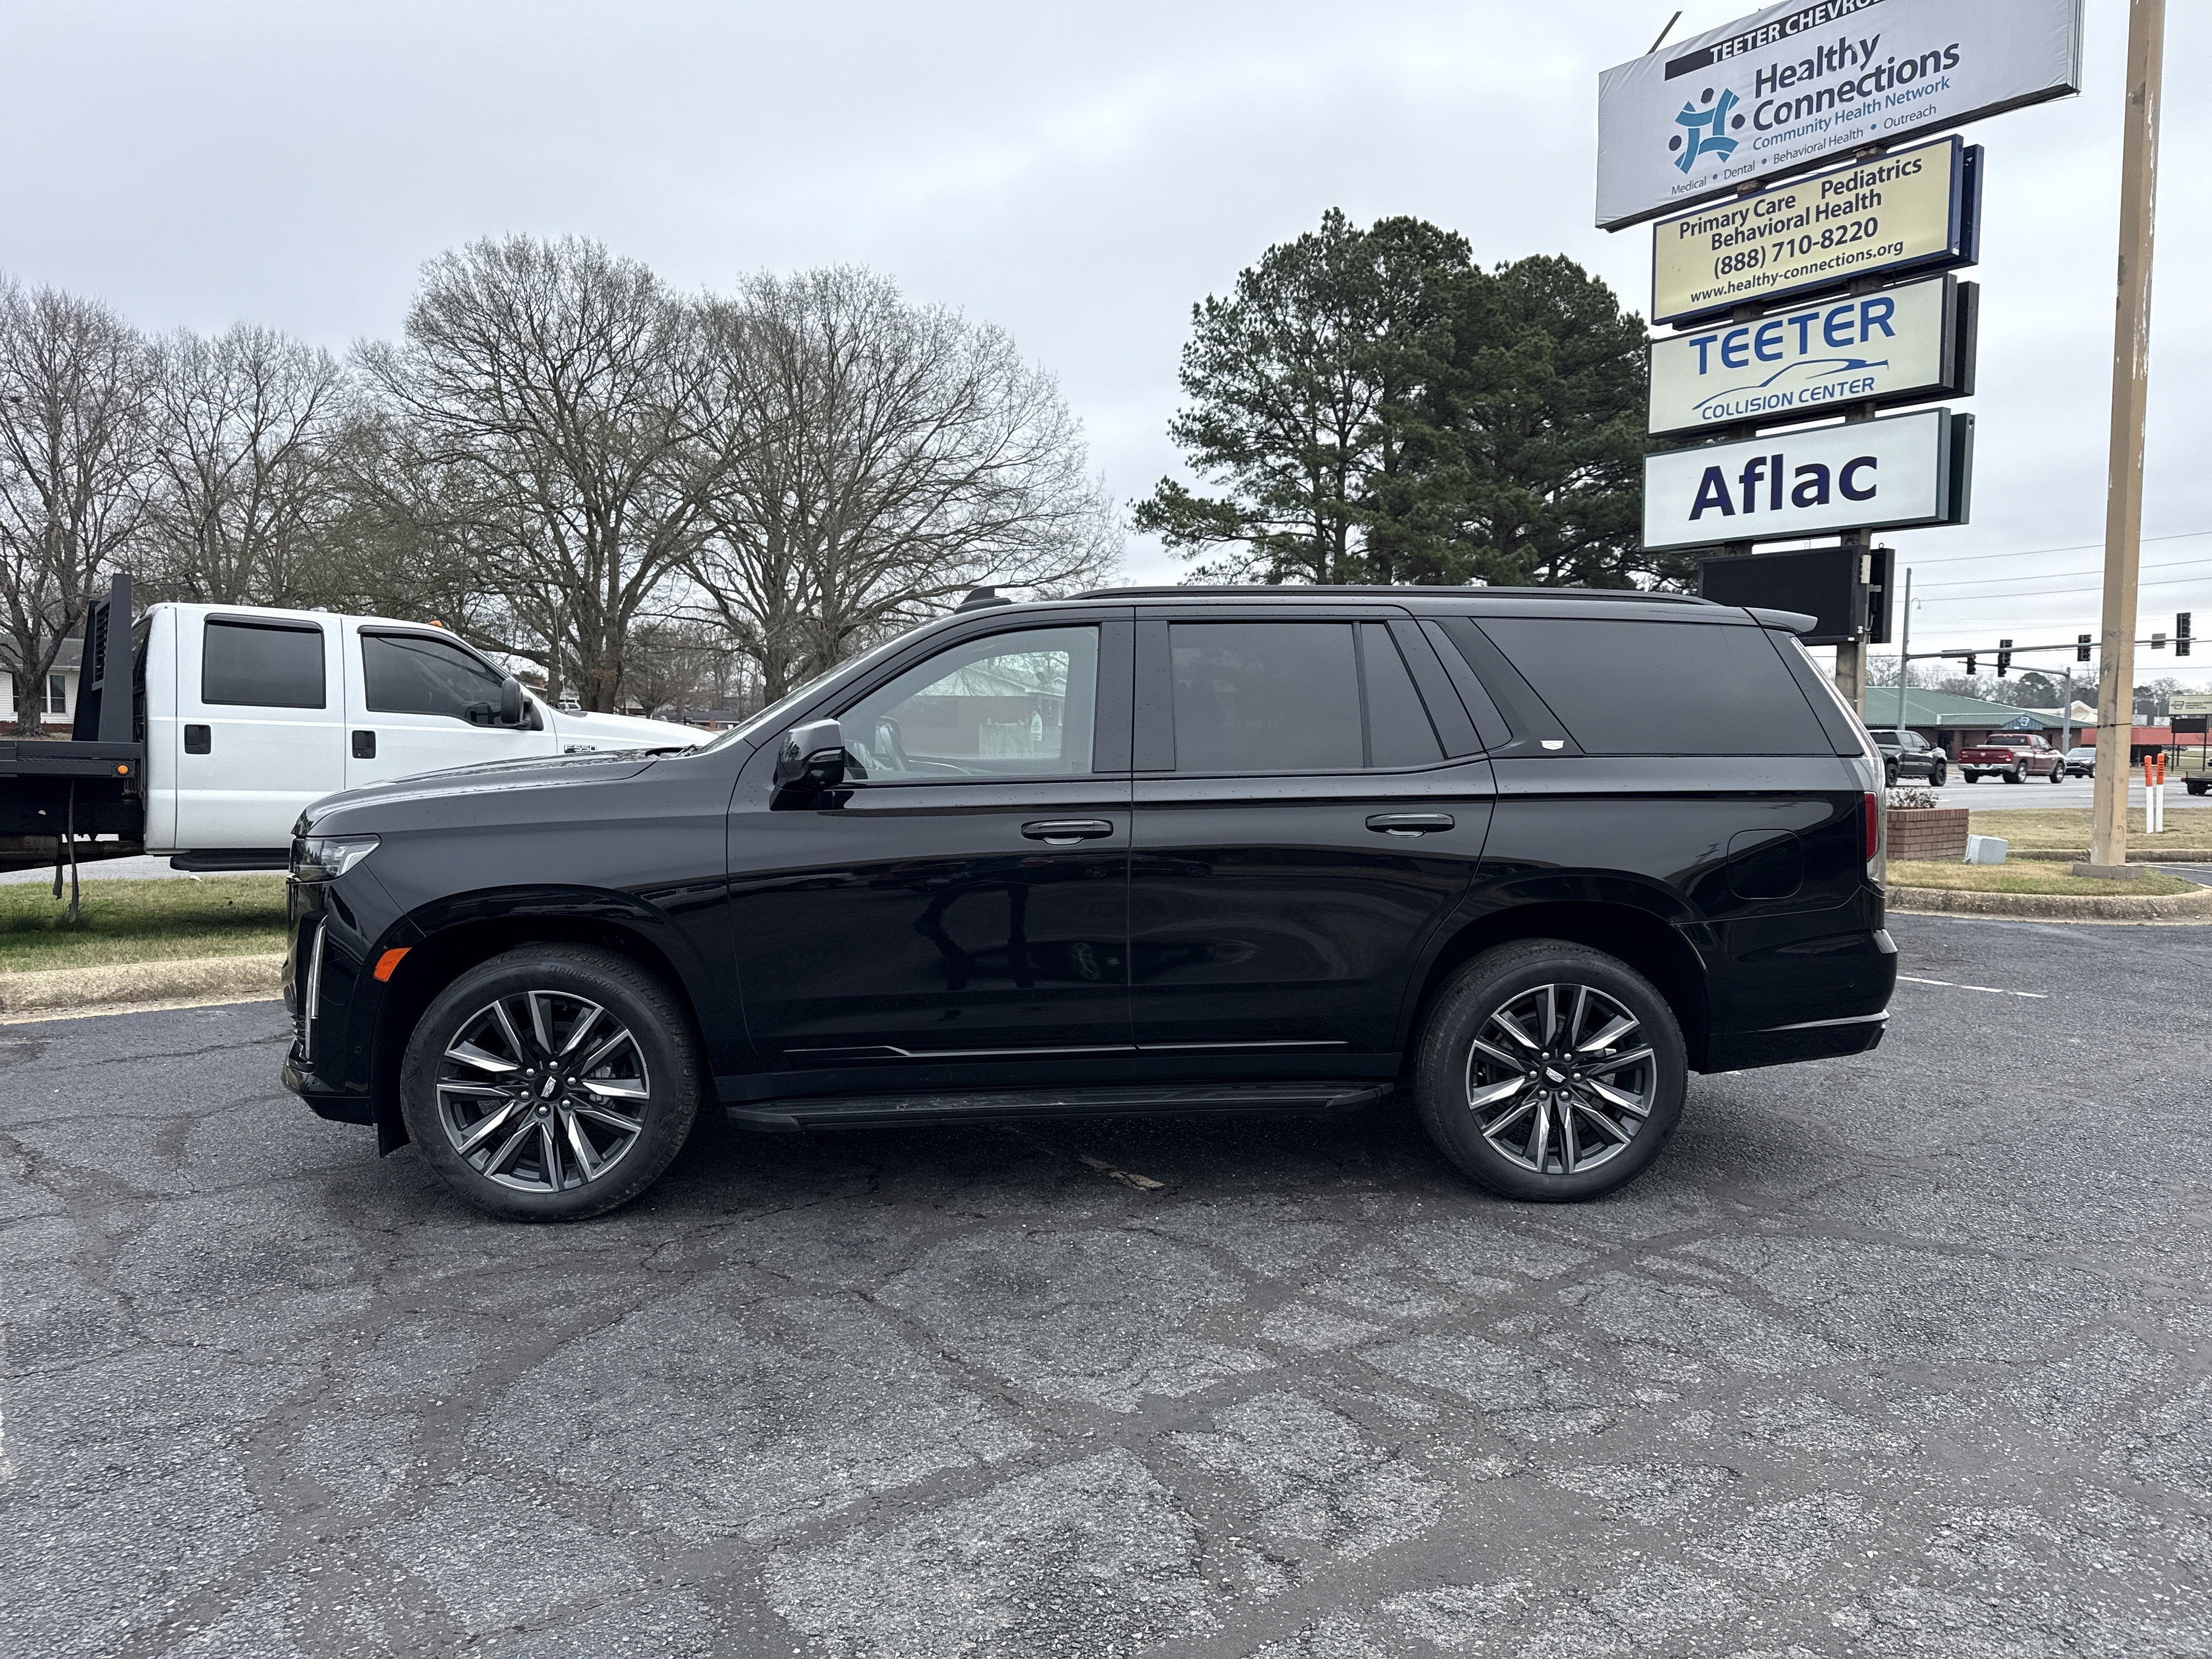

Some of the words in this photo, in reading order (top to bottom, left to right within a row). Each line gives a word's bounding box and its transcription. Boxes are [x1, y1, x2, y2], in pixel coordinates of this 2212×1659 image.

[1710, 24, 1780, 63] TEETER
[1755, 33, 1881, 99] Healthy
[1753, 43, 1960, 131] Connections
[1753, 116, 1832, 150] Community
[1835, 99, 1881, 125] Health
[1885, 75, 1951, 109] Network
[1671, 176, 1707, 196] Medical
[1724, 160, 1756, 180] Dental
[1773, 138, 1826, 165] Behavioral
[1829, 127, 1864, 147] Health
[1883, 104, 1936, 129] Outreach
[1679, 206, 1750, 239] Primary
[1753, 195, 1796, 217] Care
[1820, 157, 1922, 200] Pediatrics
[1711, 207, 1810, 251] Behavioral
[1815, 189, 1882, 222] Health
[1690, 240, 1904, 303] www.healthy-connections.org
[1714, 245, 1767, 280] (888)
[1771, 217, 1879, 262] 710-8220
[1689, 297, 1896, 375] TEETER
[1702, 391, 1794, 421] COLLISION
[1798, 376, 1875, 403] CENTER
[1688, 453, 1878, 521] Aflac
[547, 964, 626, 998] BRIDGESTONE
